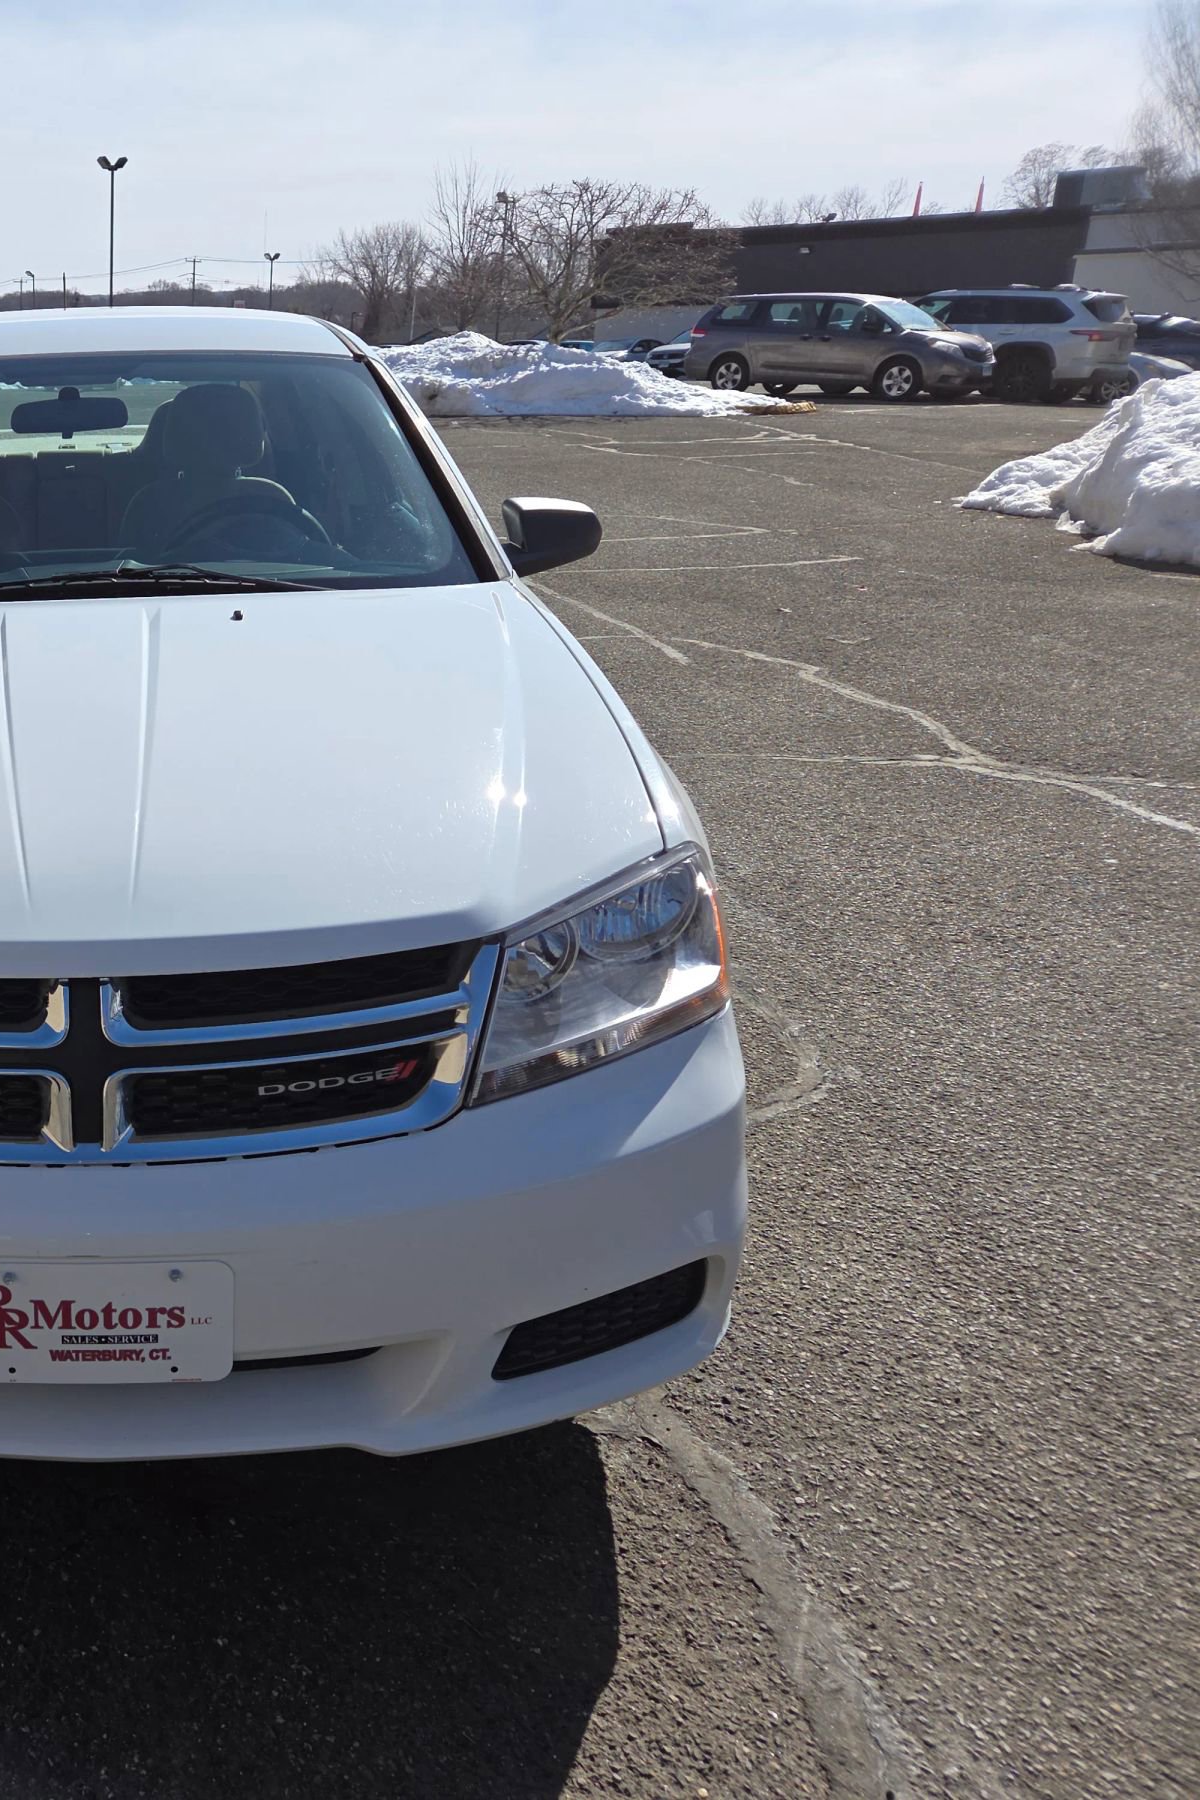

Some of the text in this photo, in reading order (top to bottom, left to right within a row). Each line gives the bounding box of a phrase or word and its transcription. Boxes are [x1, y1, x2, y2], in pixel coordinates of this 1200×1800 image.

[257, 1066, 399, 1096] DODGE
[29, 1300, 186, 1330] Motors
[190, 1316, 213, 1325] LLC
[63, 1334, 157, 1344] SALES SERVICE
[49, 1348, 172, 1363] WATERBURY, CT.
